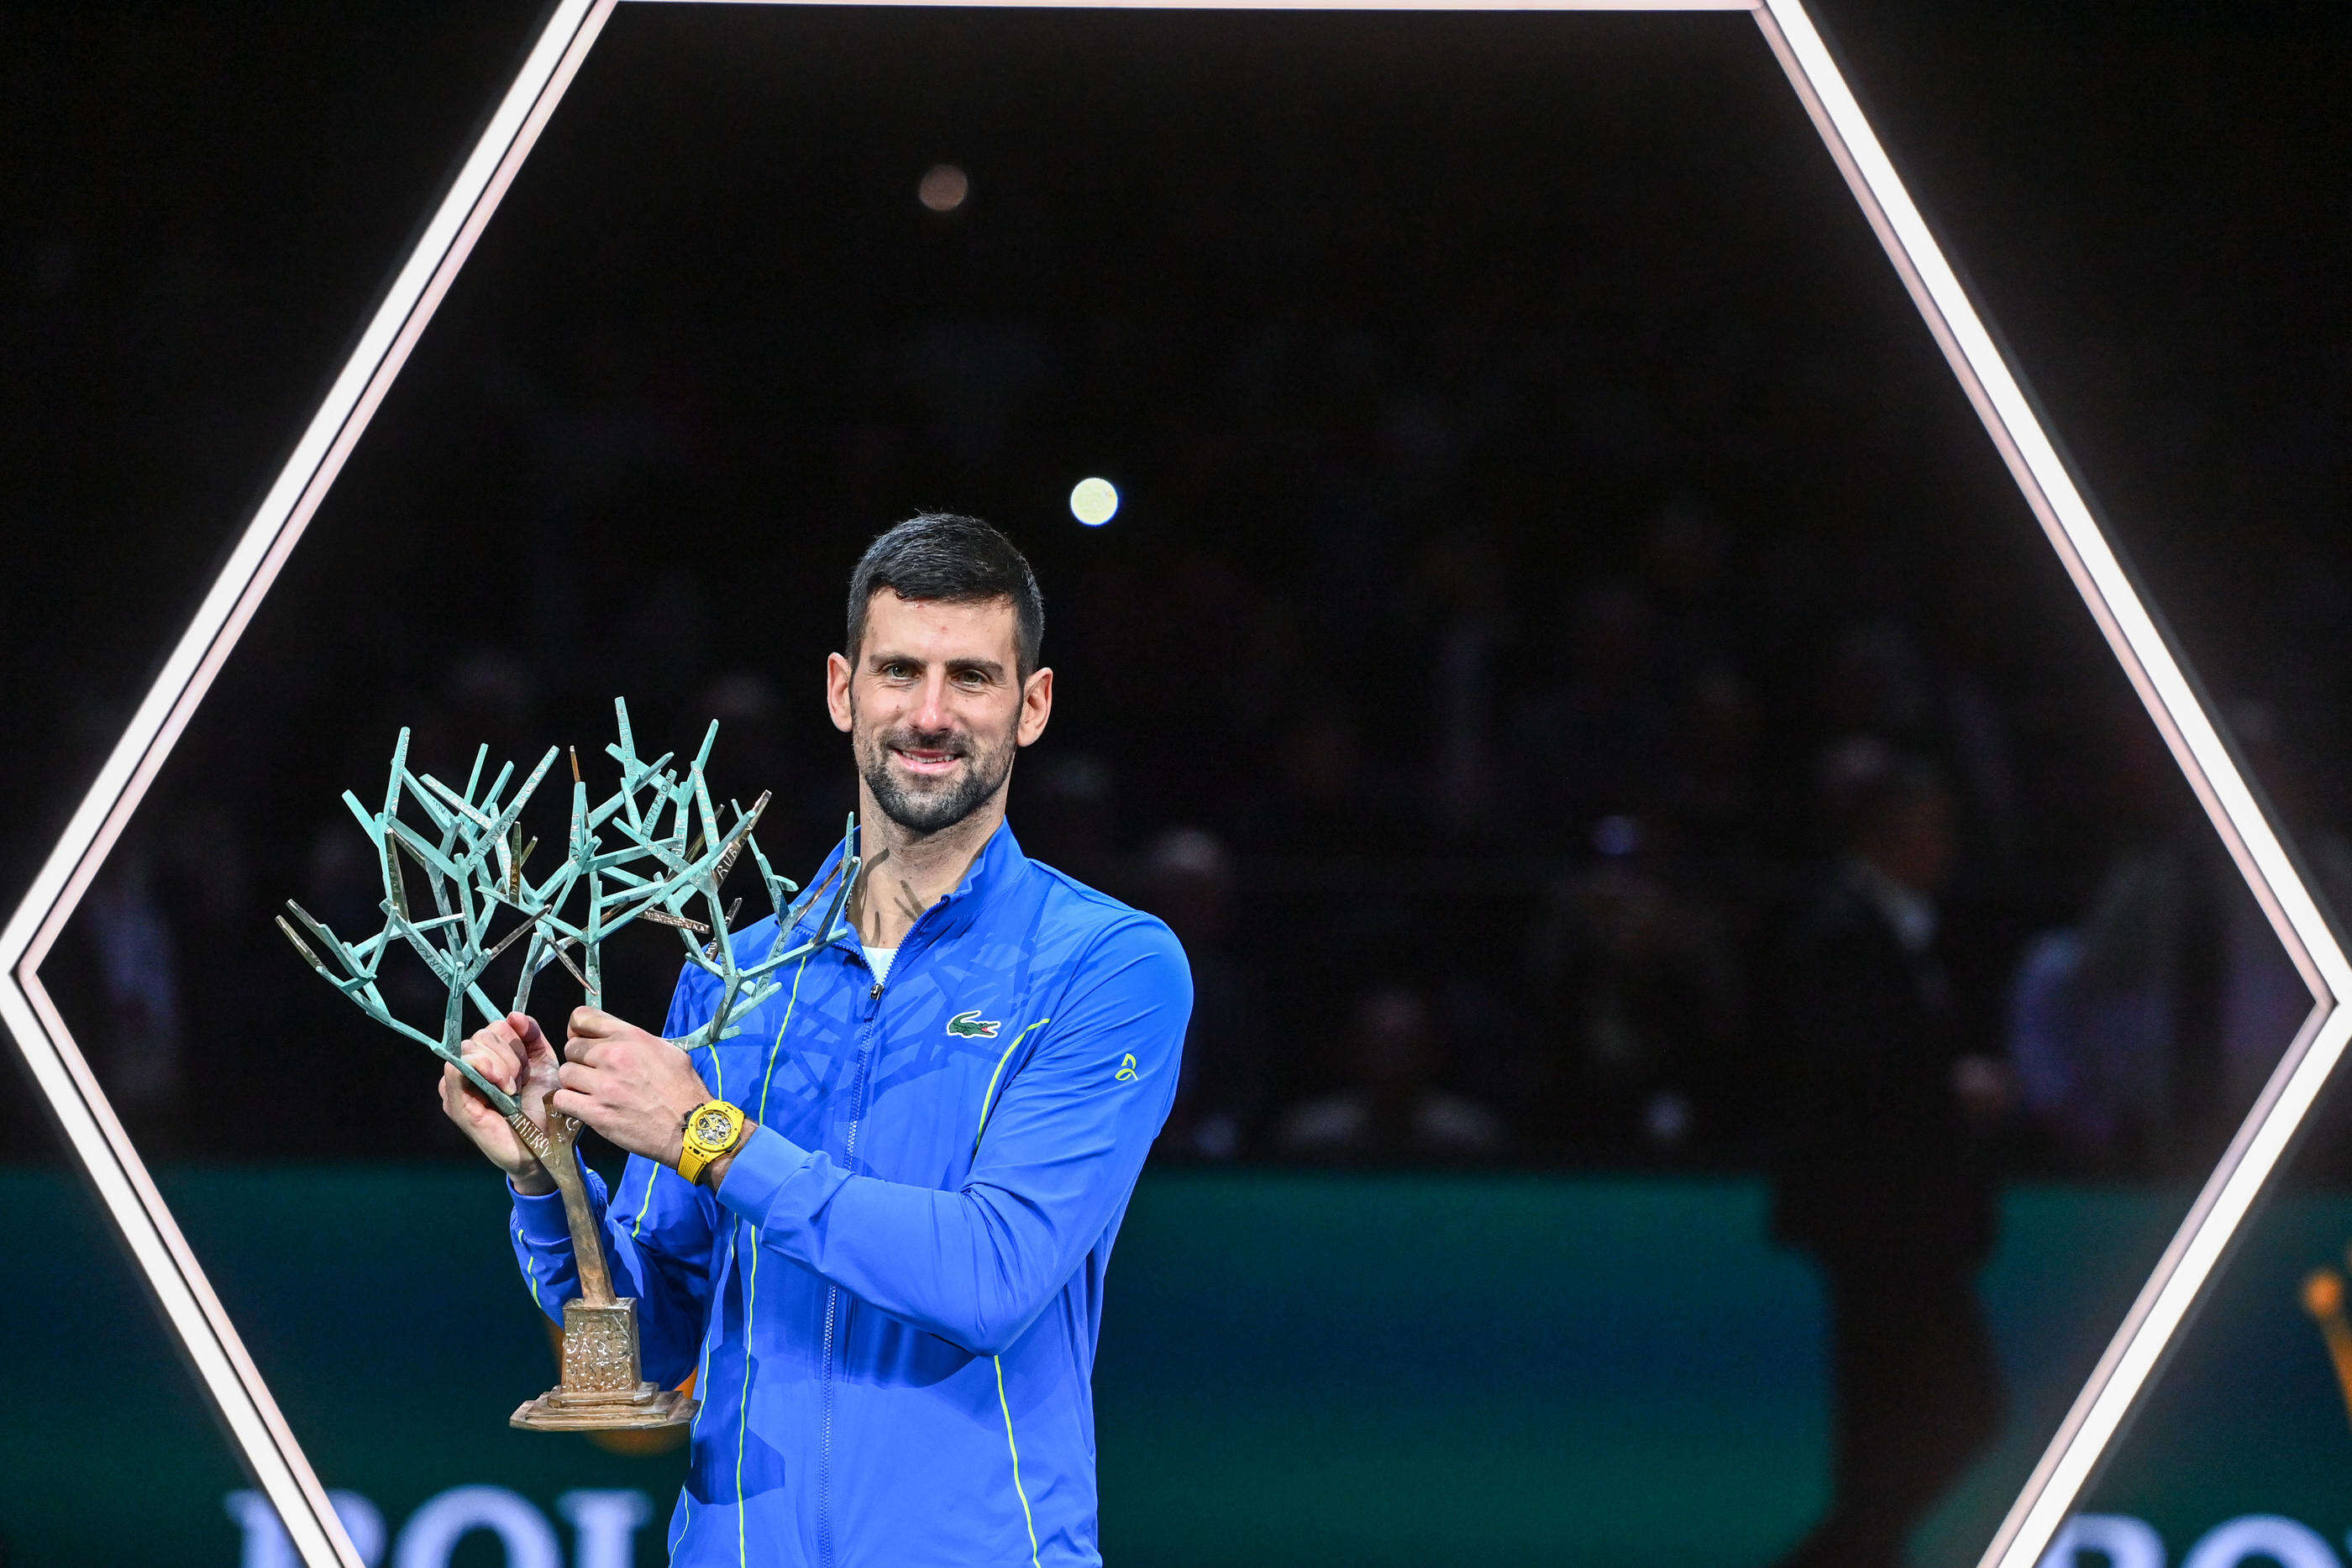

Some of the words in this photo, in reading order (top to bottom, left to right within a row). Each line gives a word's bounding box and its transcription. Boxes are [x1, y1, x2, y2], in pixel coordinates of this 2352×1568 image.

[640, 771, 675, 836] THOMPSON
[468, 811, 515, 867] MONFILS
[509, 1113, 553, 1158] IMITROV
